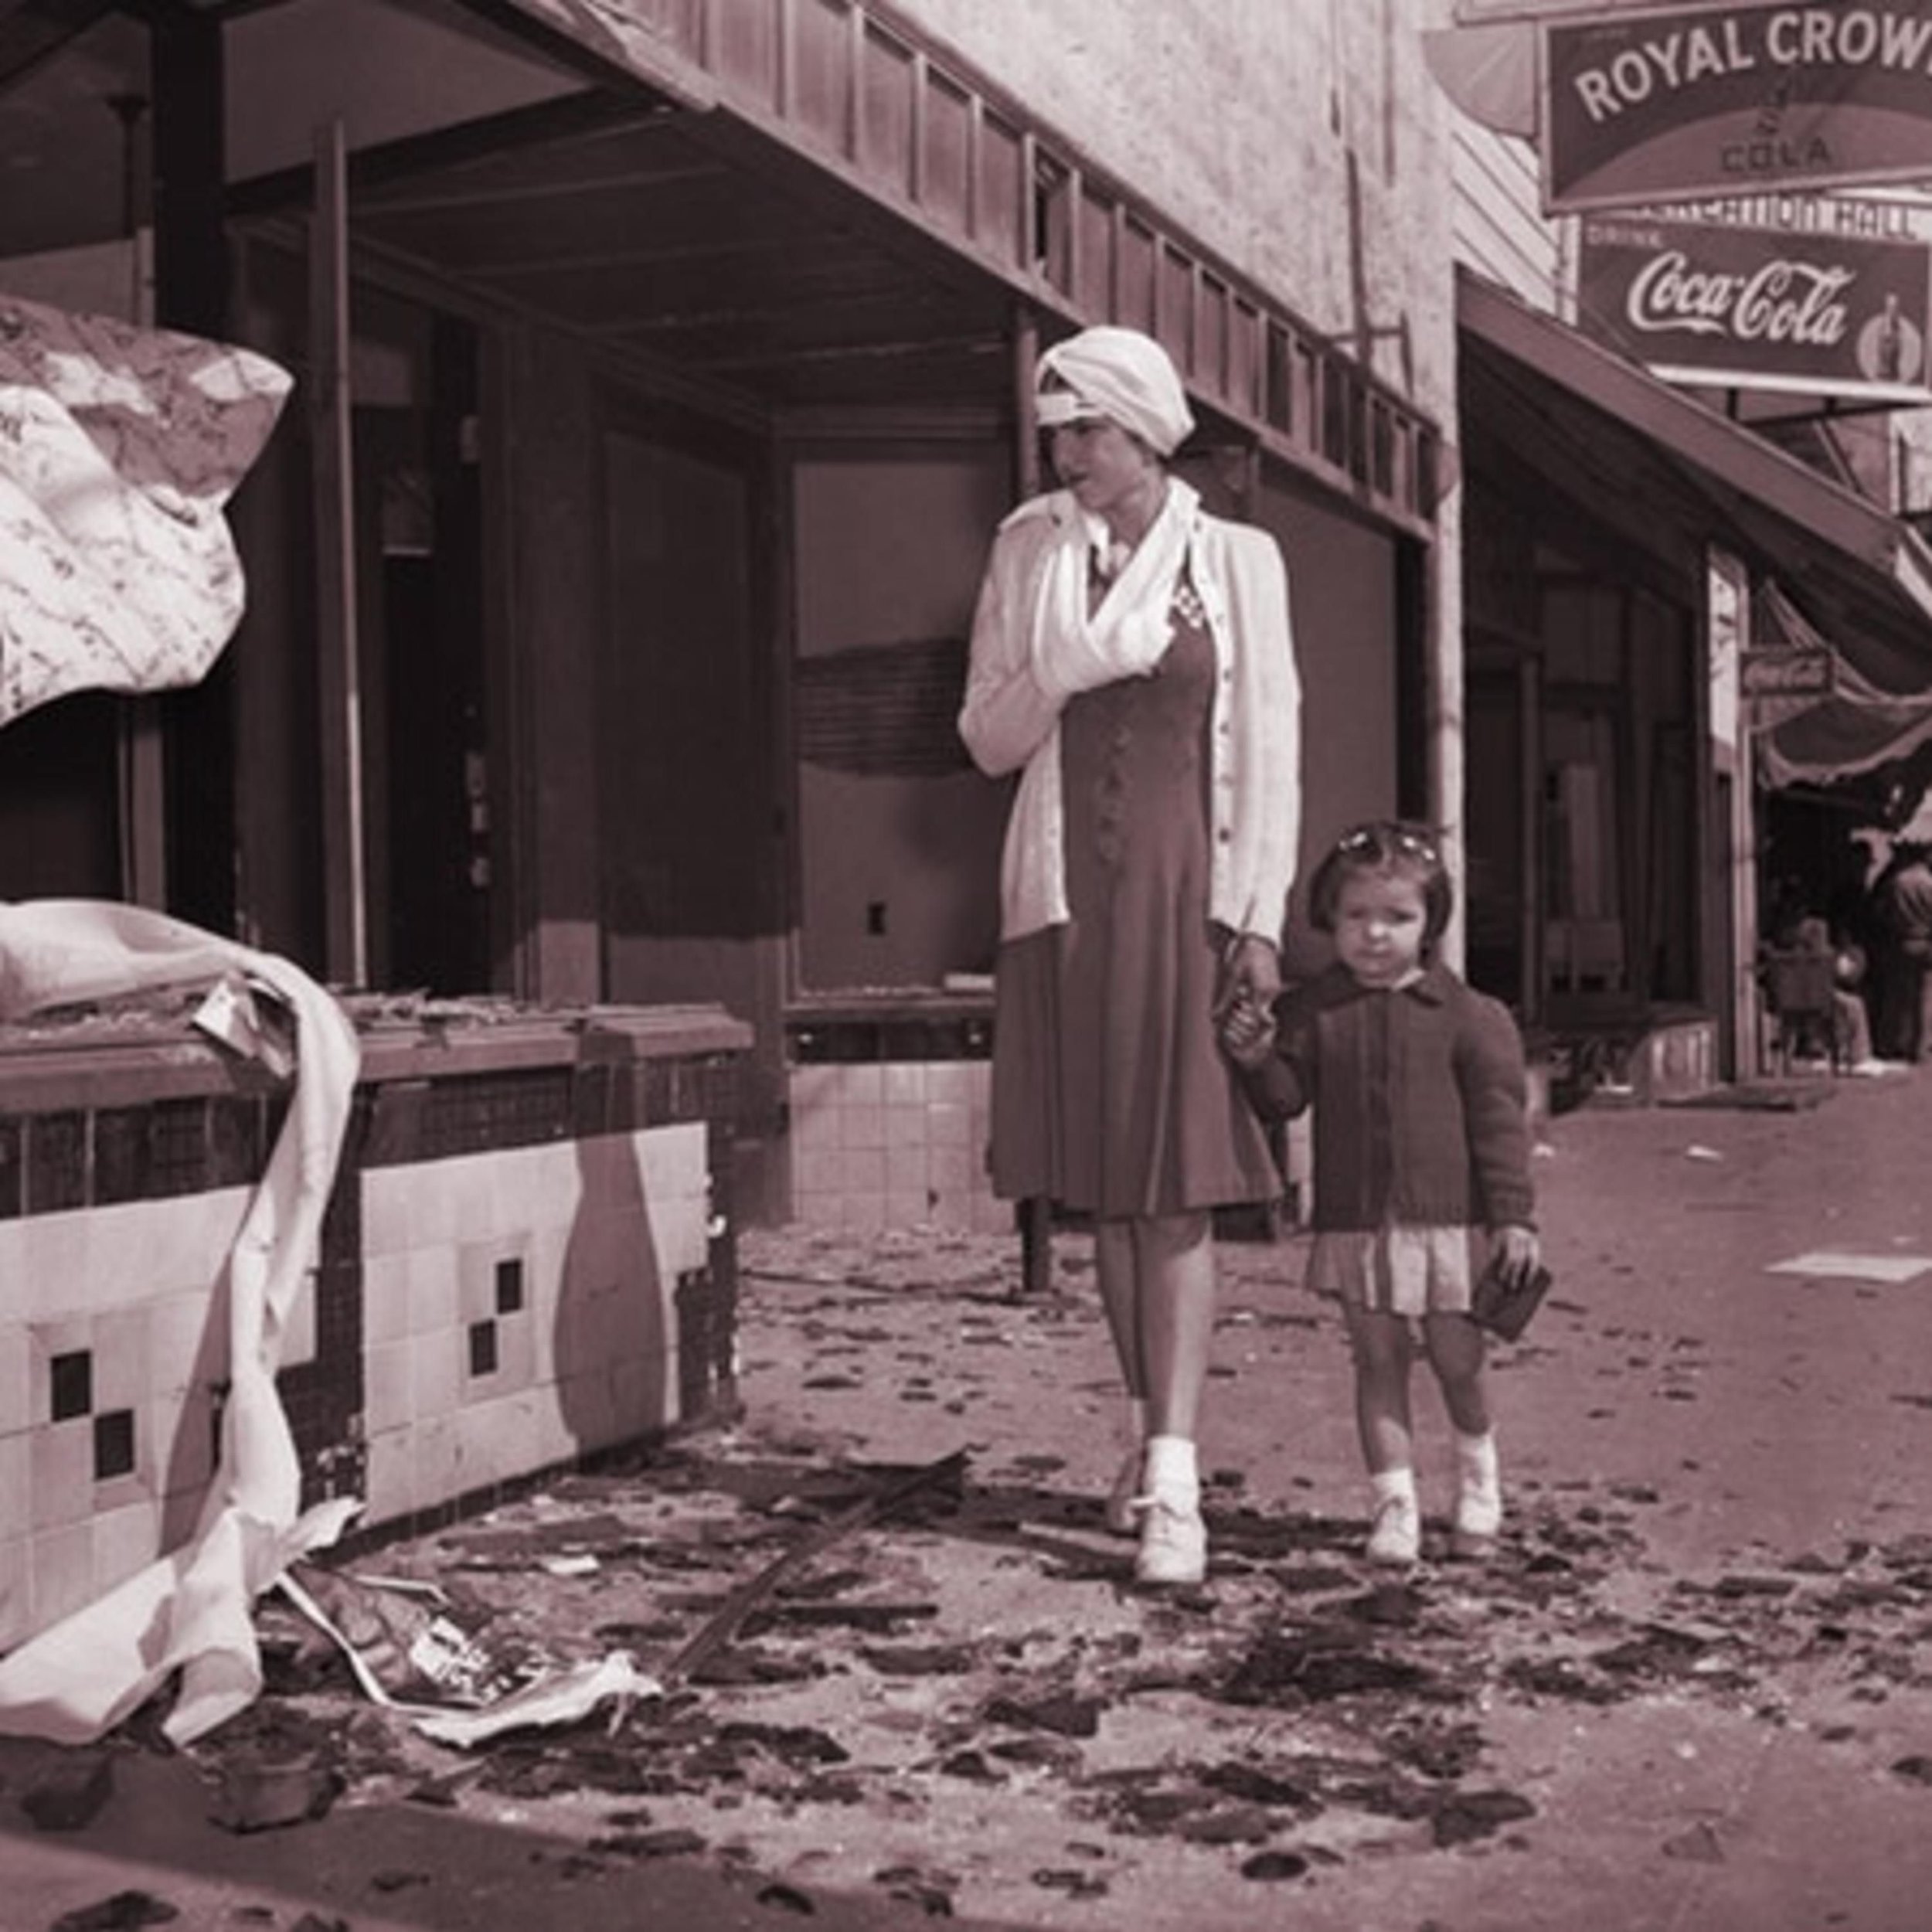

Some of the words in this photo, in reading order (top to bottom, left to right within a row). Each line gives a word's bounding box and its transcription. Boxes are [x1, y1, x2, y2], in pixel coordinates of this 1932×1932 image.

[1575, 19, 1754, 121] ROYAL
[1767, 10, 1932, 76] CROW
[1720, 136, 1832, 172] COLA
[1628, 251, 1857, 345] Coca-Cola
